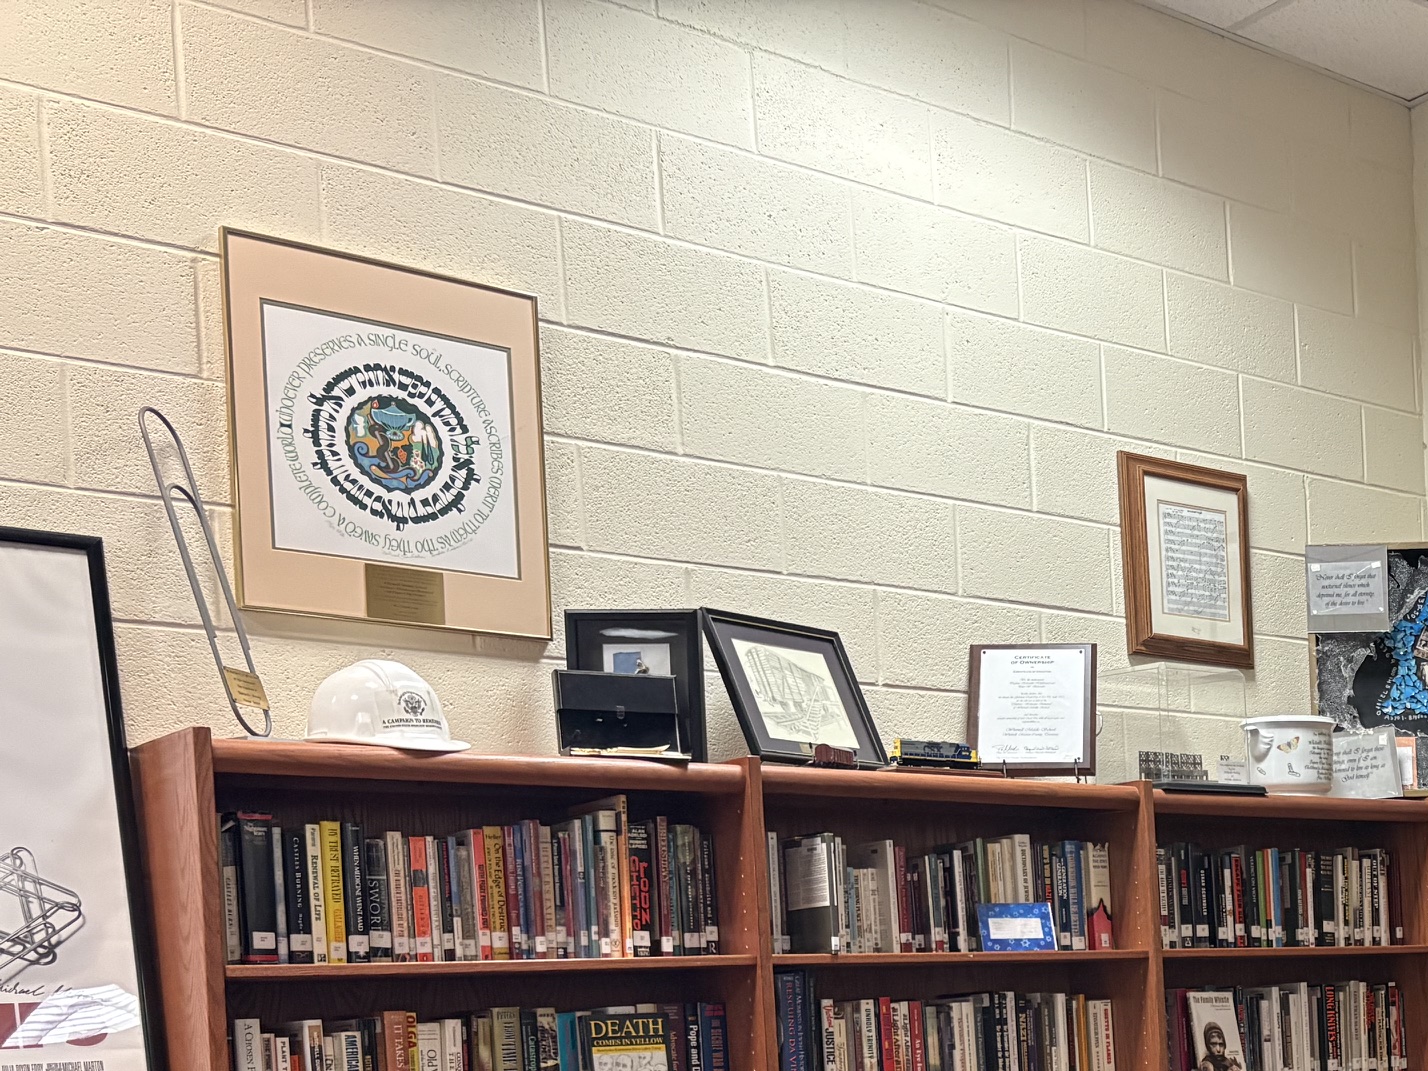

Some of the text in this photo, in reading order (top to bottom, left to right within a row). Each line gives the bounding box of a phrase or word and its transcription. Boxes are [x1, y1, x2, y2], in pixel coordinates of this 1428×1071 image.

[367, 333, 408, 352] SINGLE
[442, 363, 490, 418] SCRIPTURE
[311, 855, 320, 890] RENEWAL
[328, 839, 341, 904] TRUST BETRAYED
[354, 866, 362, 896] MEDICINE
[494, 843, 505, 890] On the Edge
[295, 873, 303, 908] BURNING
[629, 855, 642, 931] GHETTO
[786, 982, 795, 1031] RESCUING
[1325, 986, 1336, 1042] LONG KNIVES
[392, 1024, 401, 1035] IT
[406, 1015, 417, 1050] OLGA
[590, 1018, 665, 1038] DEATH
[593, 1036, 664, 1047] COMES IN YELLOW
[689, 1024, 699, 1047] Pope
[244, 1032, 254, 1065] CHOSEN
[394, 1037, 404, 1069] TAKES
[426, 1048, 438, 1067] Old
[503, 1043, 518, 1065] TIME
[690, 1048, 700, 1066] and
[825, 1028, 836, 1066] JUSTICE
